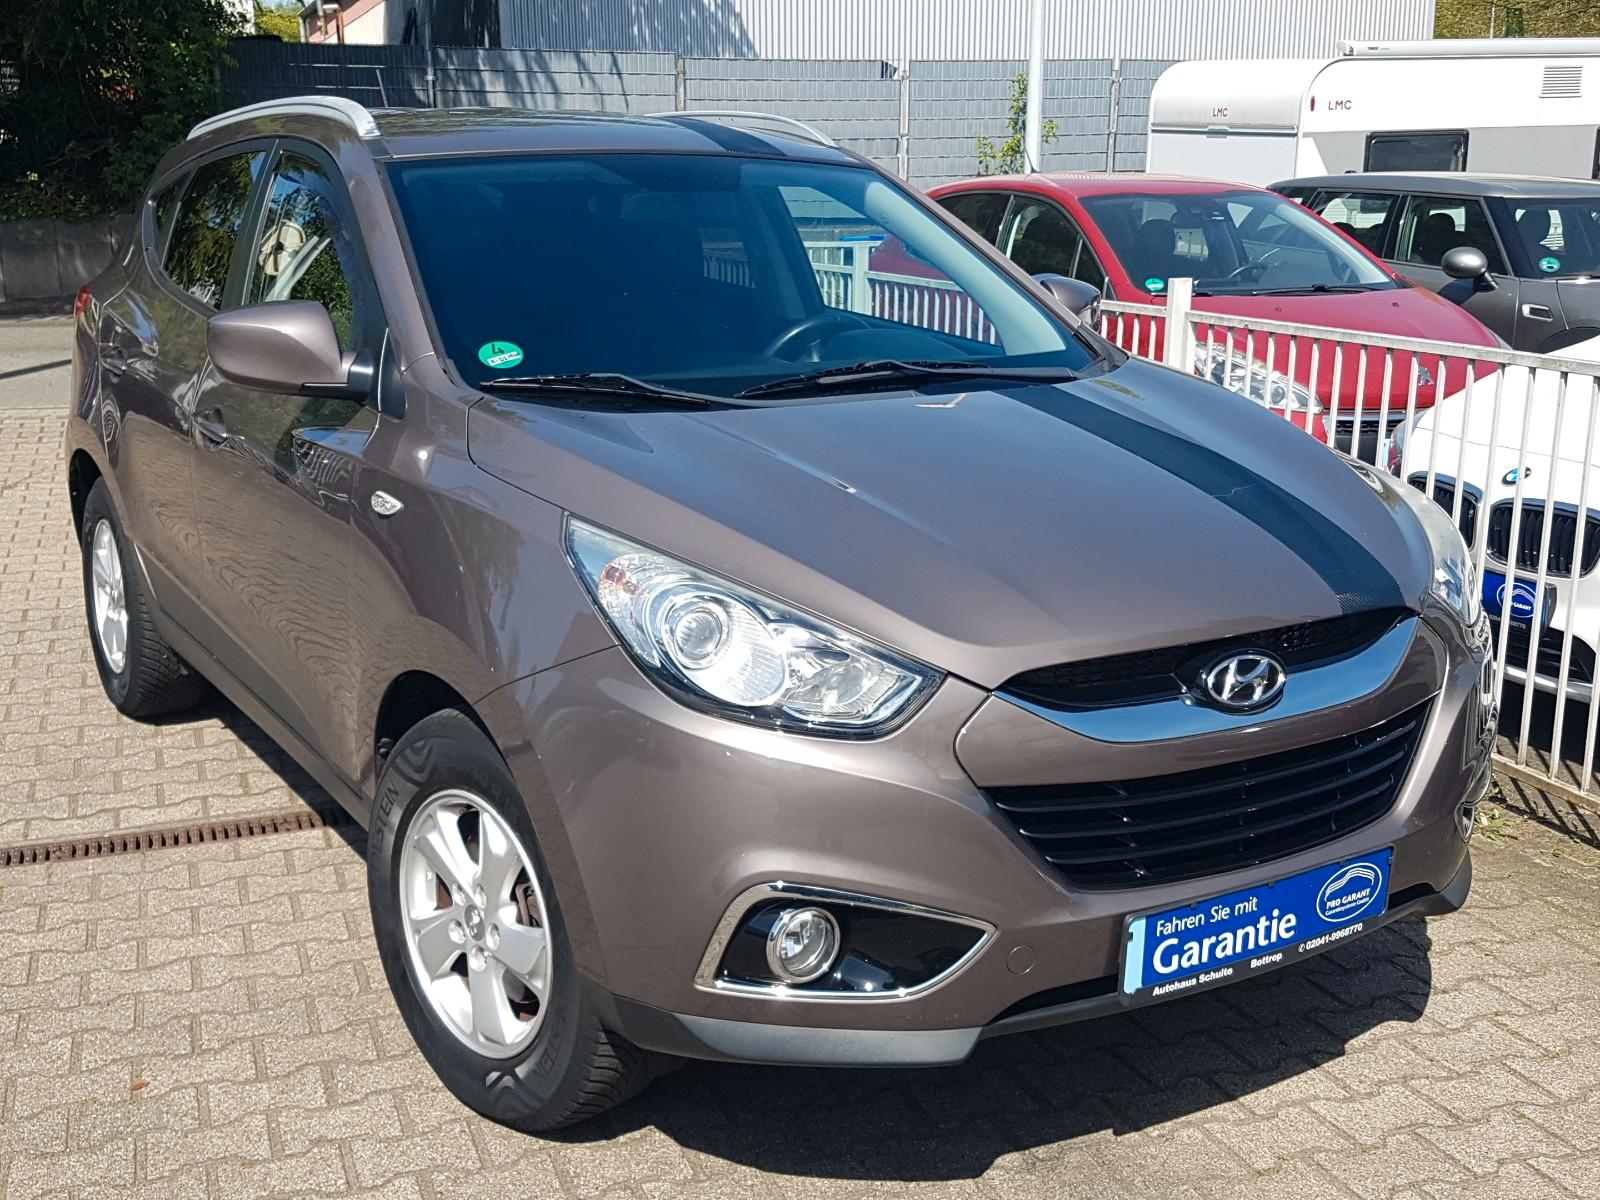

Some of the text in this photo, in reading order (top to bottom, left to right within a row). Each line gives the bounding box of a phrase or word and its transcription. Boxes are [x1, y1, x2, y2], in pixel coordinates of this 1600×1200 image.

[1212, 107, 1229, 118] LMC
[1327, 100, 1353, 111] LMC
[491, 343, 505, 355] 4
[1326, 887, 1371, 910] PRO GARANT
[1156, 896, 1258, 937] Fahren Sie mit
[1152, 908, 1297, 974] Garantie
[1152, 922, 1363, 997] Autohaus Schulte Bottrop 02041-9968770
